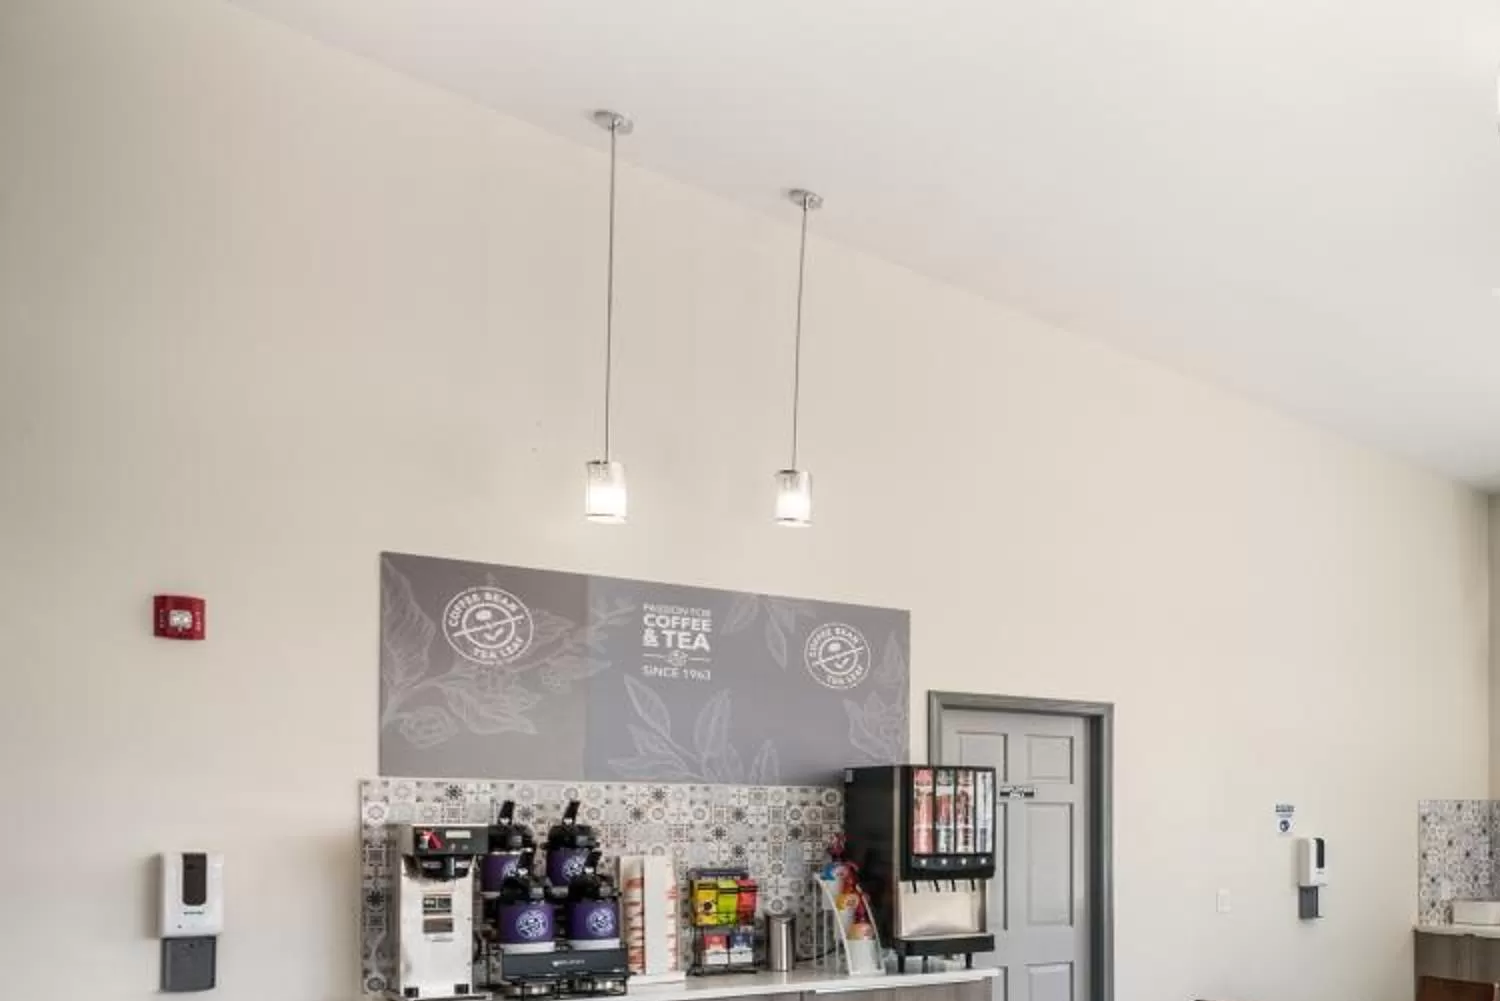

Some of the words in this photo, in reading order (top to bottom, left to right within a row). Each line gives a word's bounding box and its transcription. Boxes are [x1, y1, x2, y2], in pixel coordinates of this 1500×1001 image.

[643, 613, 712, 632] COFFEE
[642, 628, 659, 647] &
[661, 629, 710, 652] TEA
[643, 665, 680, 678] SINCE
